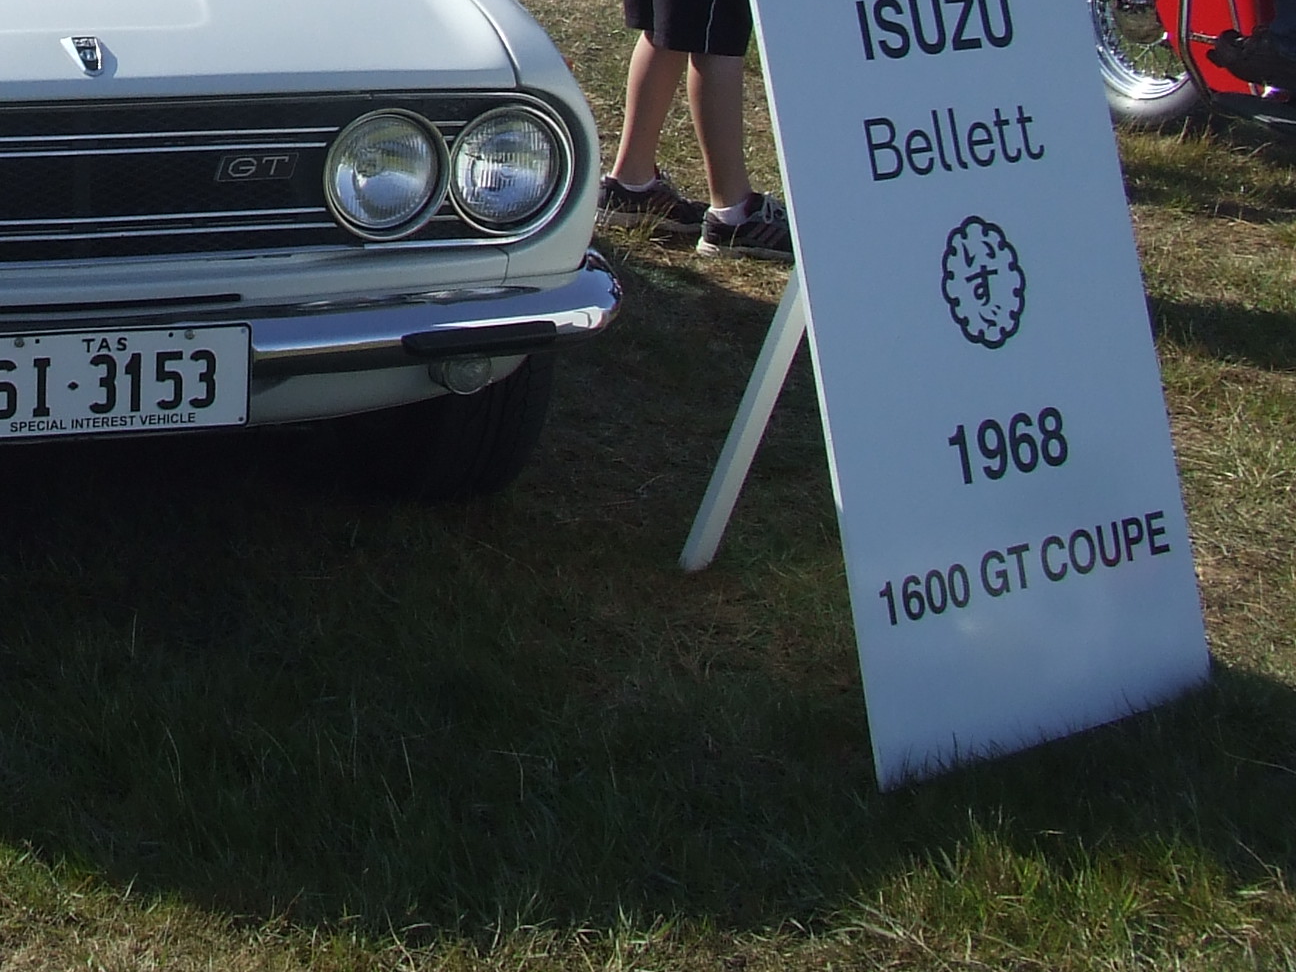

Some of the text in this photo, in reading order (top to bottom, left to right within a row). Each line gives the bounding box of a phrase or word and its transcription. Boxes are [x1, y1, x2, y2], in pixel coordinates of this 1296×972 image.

[227, 155, 290, 178] GT
[863, 105, 1045, 182] Bellett
[82, 337, 129, 353] TAS
[9, 412, 197, 433] SPECIAL INTEREST VEHICLE
[947, 406, 1069, 485] 1968
[878, 510, 1171, 626] 1600 GT COUPE
